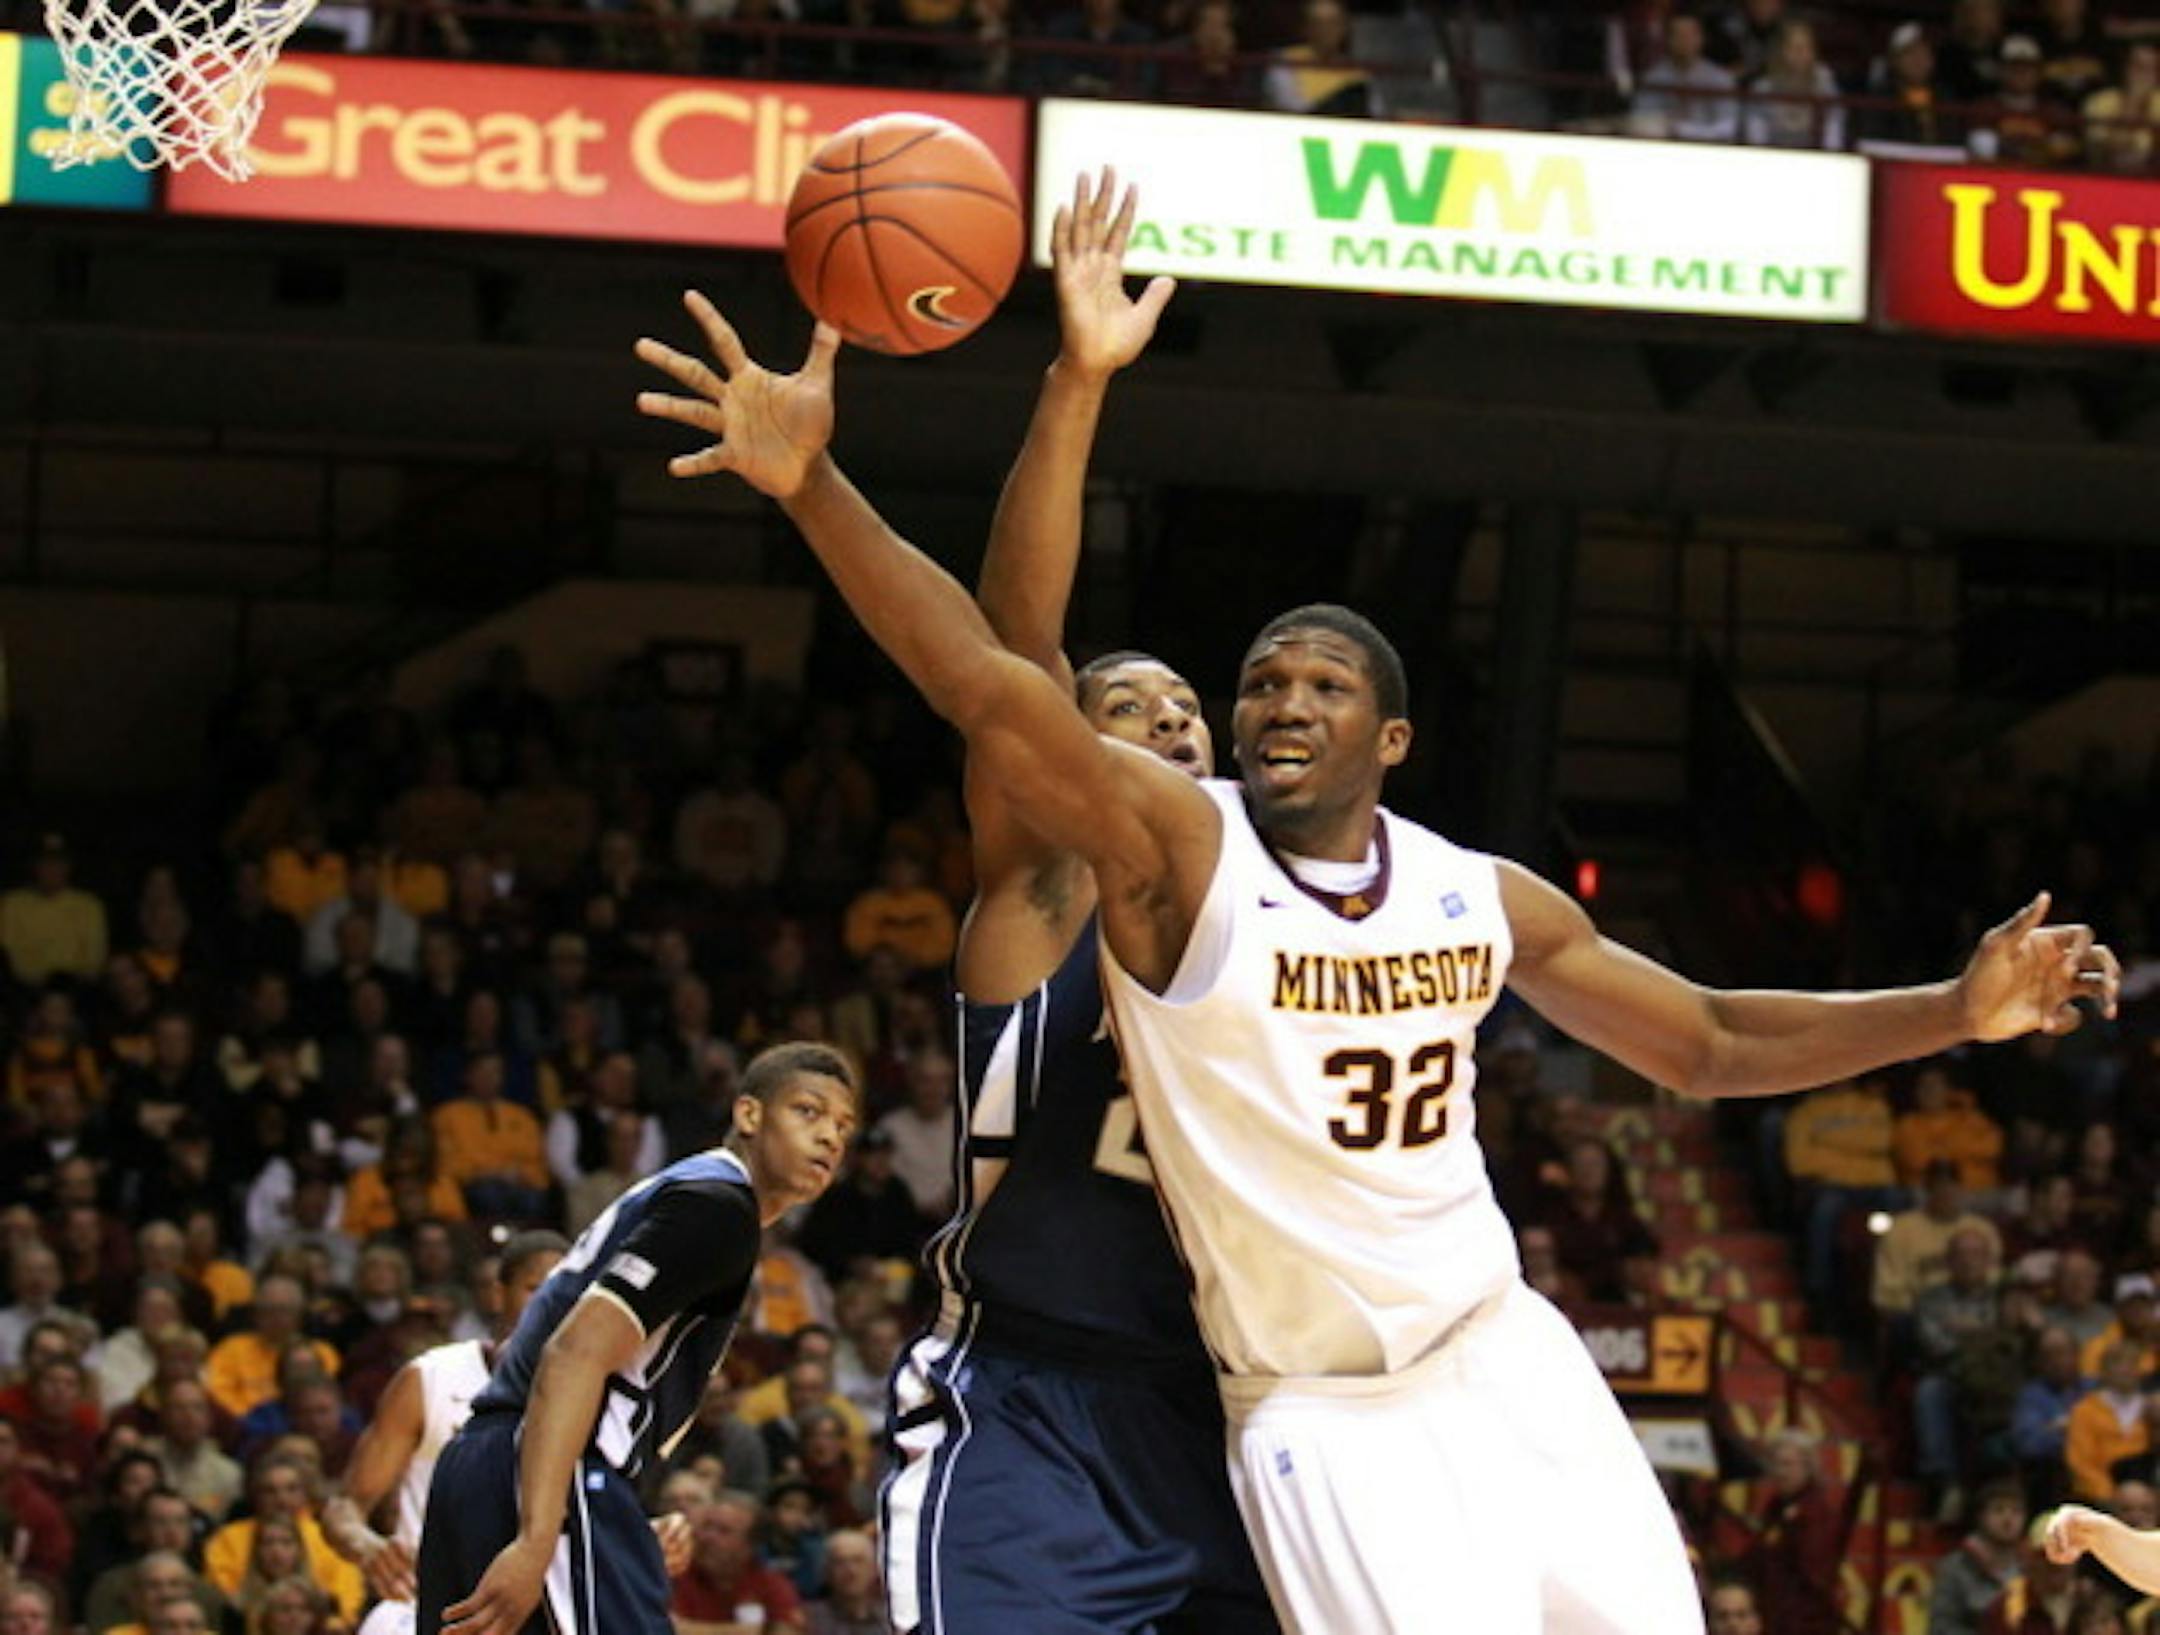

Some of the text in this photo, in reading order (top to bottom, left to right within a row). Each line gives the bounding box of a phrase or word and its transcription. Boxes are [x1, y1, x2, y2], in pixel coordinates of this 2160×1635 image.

[210, 62, 608, 196] Great
[629, 89, 833, 207] Cli
[1302, 136, 1593, 237] WM
[1126, 221, 1848, 300] ASTE MANAGEMENT
[1271, 943, 1493, 1015] MINNESOTA
[1322, 1038, 1456, 1152] 32
